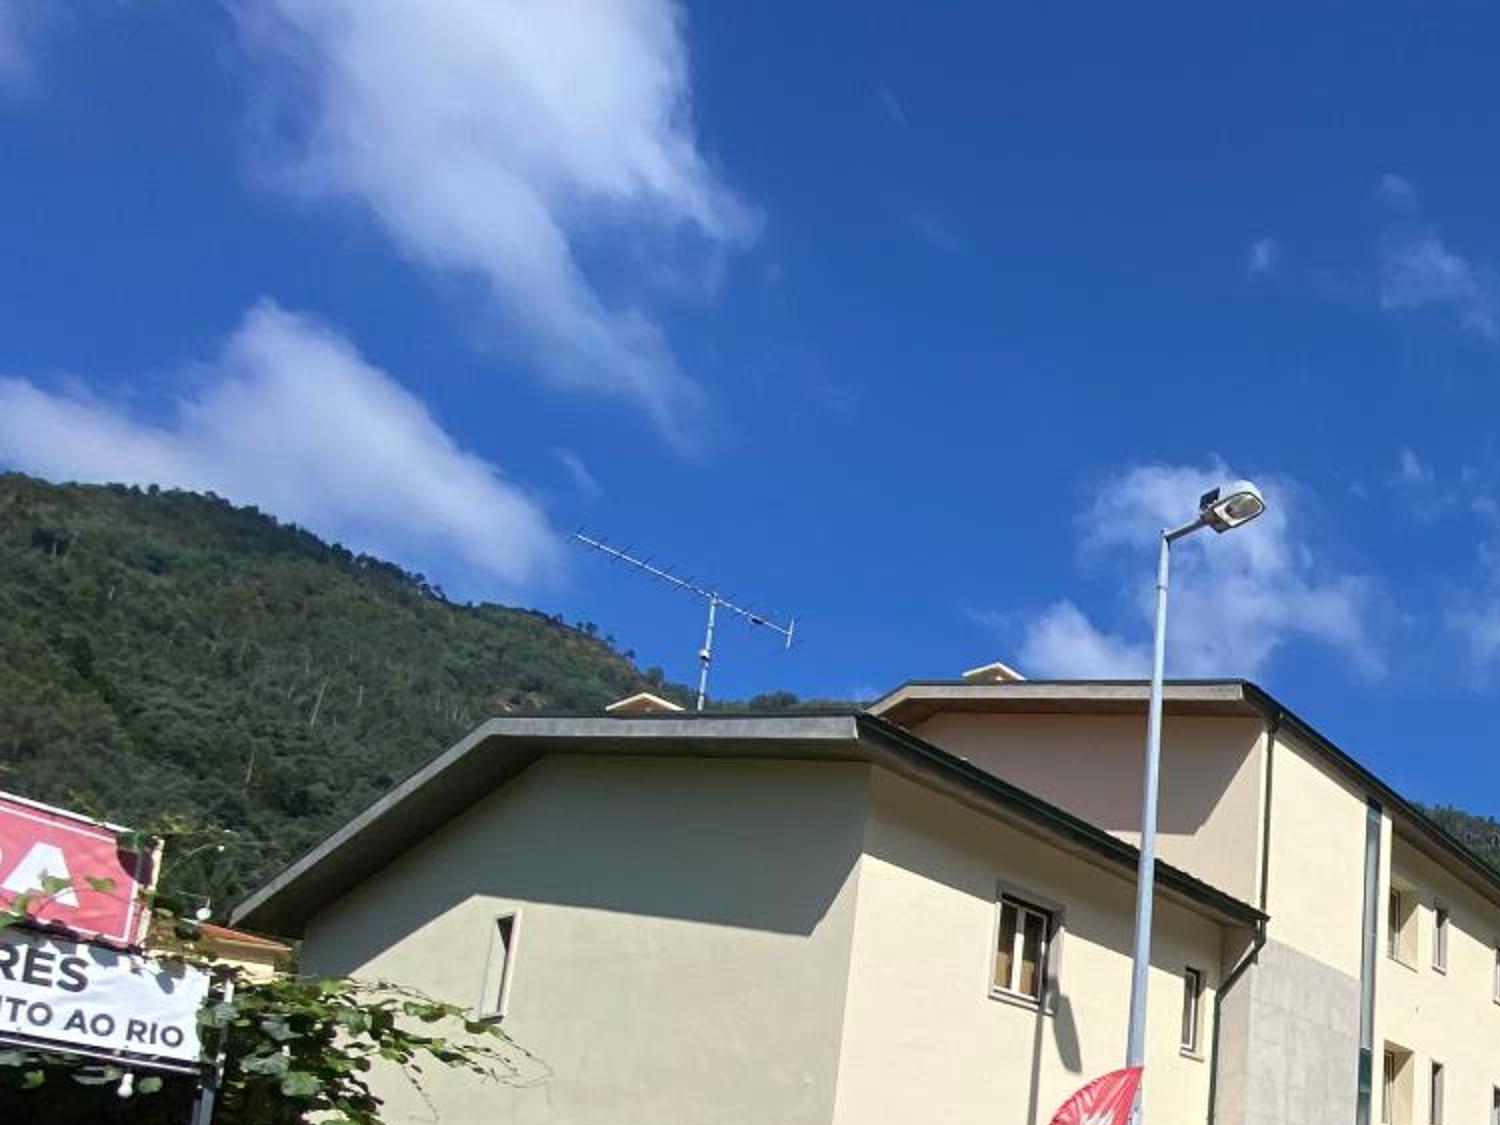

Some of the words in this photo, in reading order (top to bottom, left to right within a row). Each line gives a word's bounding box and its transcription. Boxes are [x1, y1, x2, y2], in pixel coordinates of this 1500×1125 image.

[0, 842, 80, 908] A
[0, 995, 54, 1027] TO
[63, 1007, 116, 1038] AO
[125, 1019, 184, 1048] RIO
